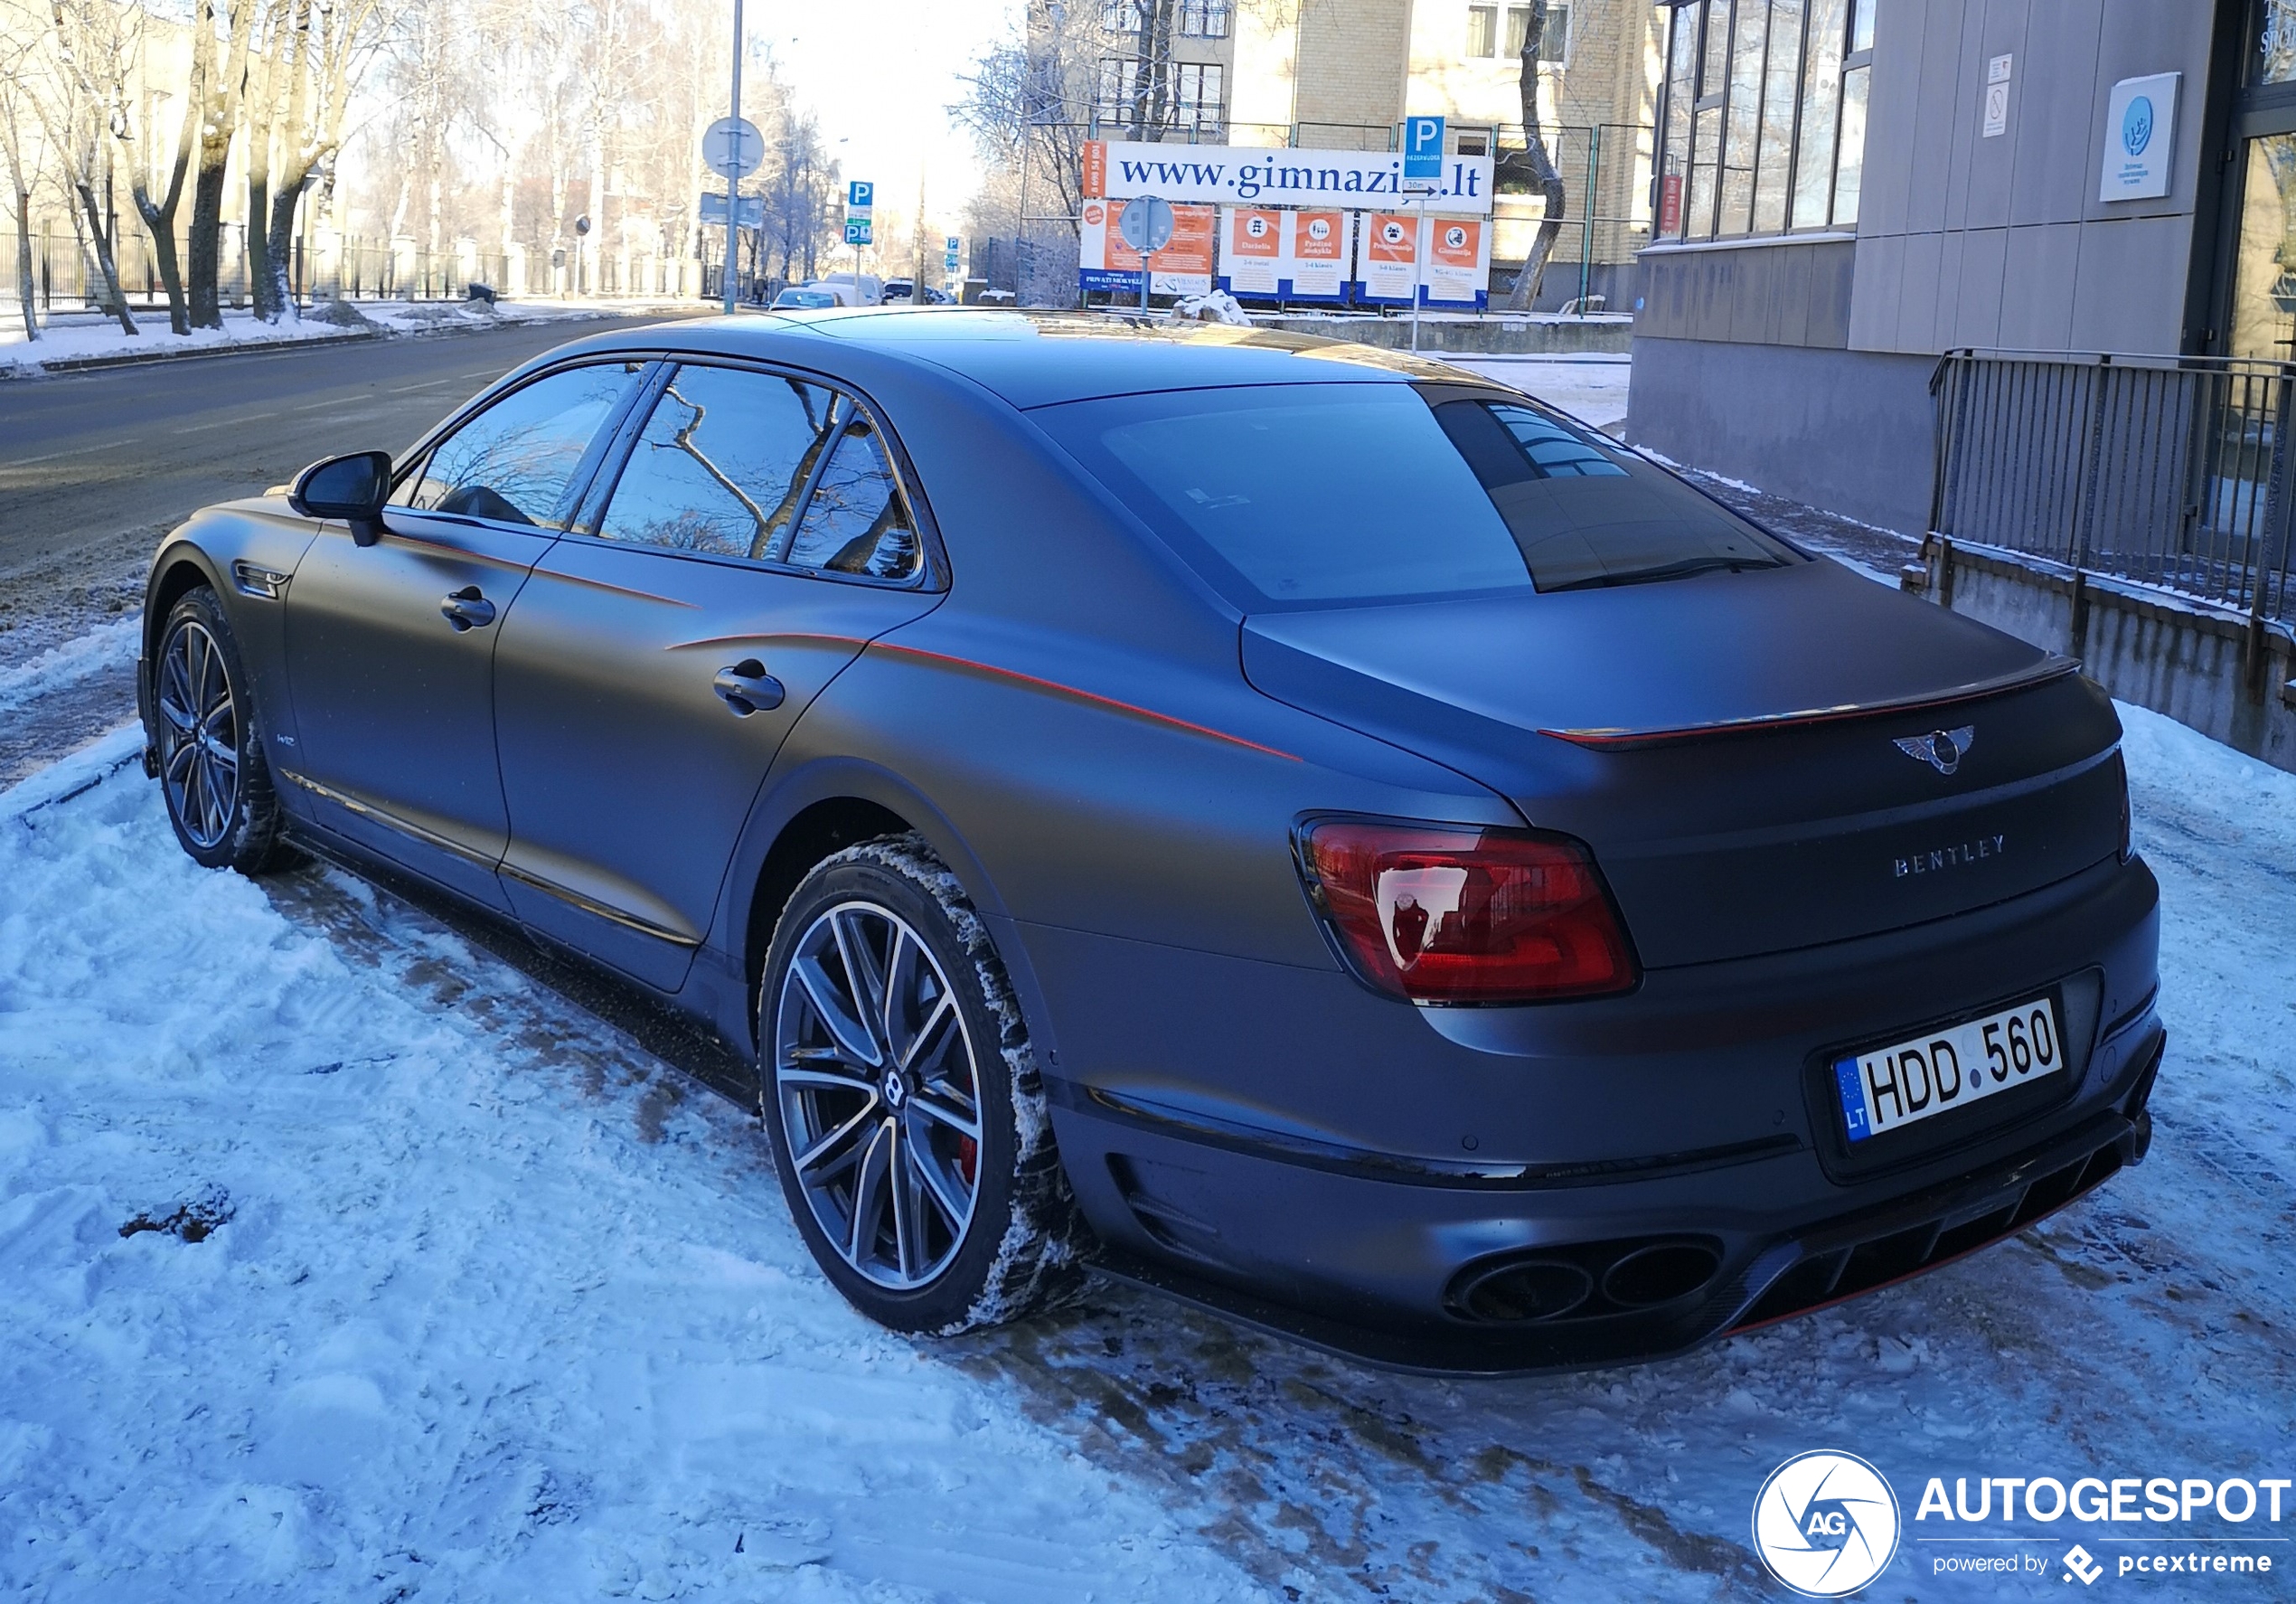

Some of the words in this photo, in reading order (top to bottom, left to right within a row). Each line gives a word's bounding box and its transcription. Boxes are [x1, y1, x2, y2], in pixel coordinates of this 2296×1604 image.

[1415, 119, 1438, 152] P
[854, 184, 870, 204] P
[1119, 156, 1482, 205] www.gimnazi.lt
[846, 225, 859, 242] P
[1894, 835, 2005, 877] BENTLEY
[1866, 1040, 1961, 1125] HDD
[1982, 1008, 2054, 1083] 560
[1846, 1106, 1866, 1130] LT
